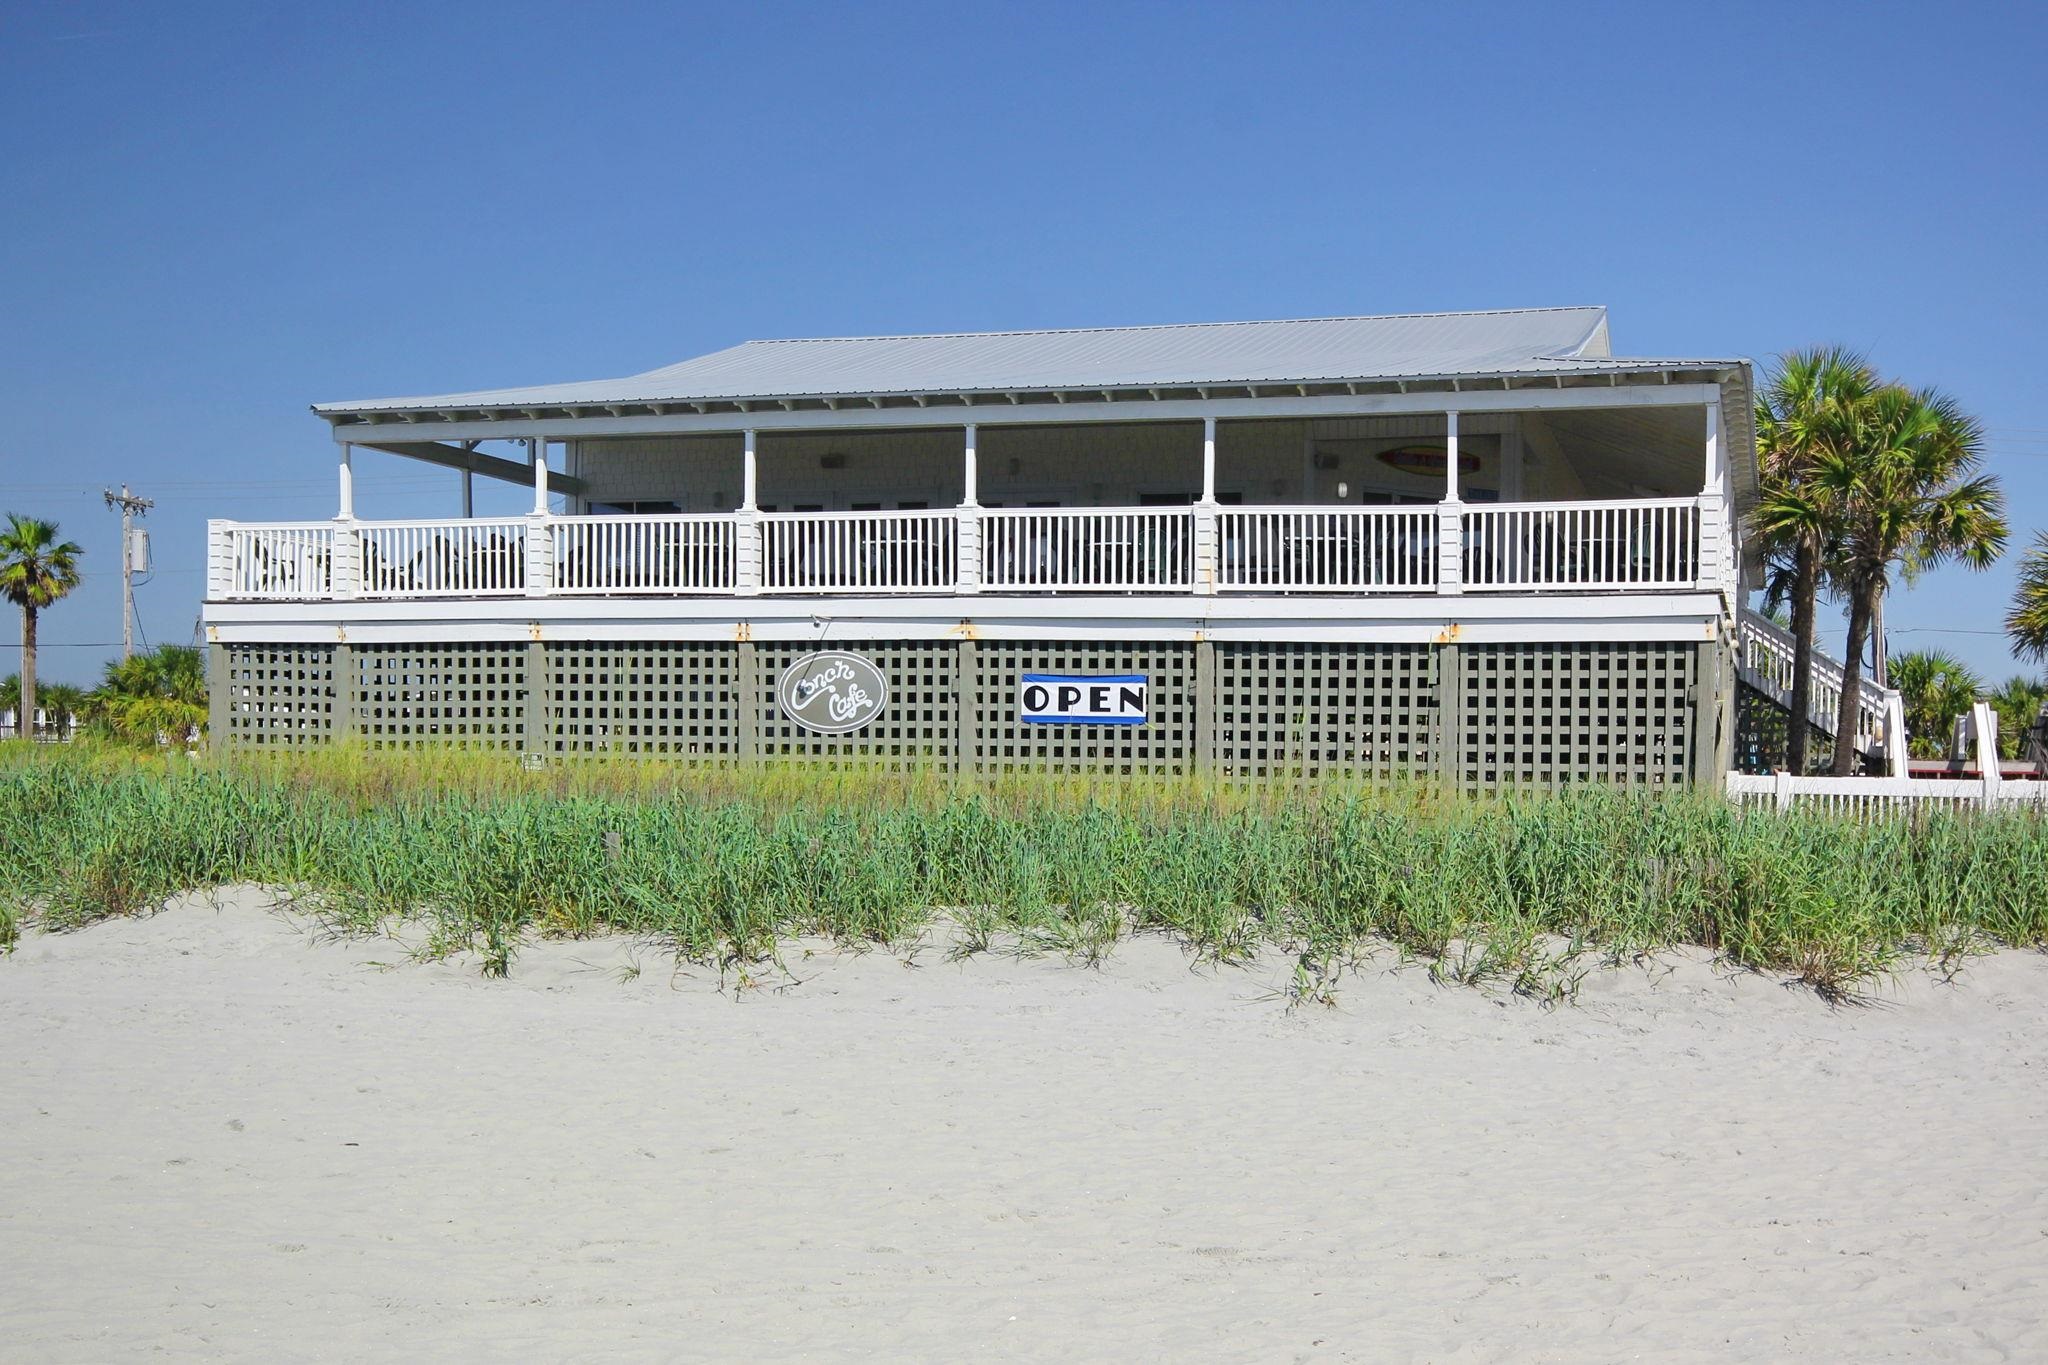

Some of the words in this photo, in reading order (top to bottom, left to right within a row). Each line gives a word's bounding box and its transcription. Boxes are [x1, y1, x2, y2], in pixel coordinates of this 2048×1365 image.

[792, 660, 856, 710] Conch
[828, 683, 873, 722] Cafe
[1023, 685, 1144, 713] OPEN
